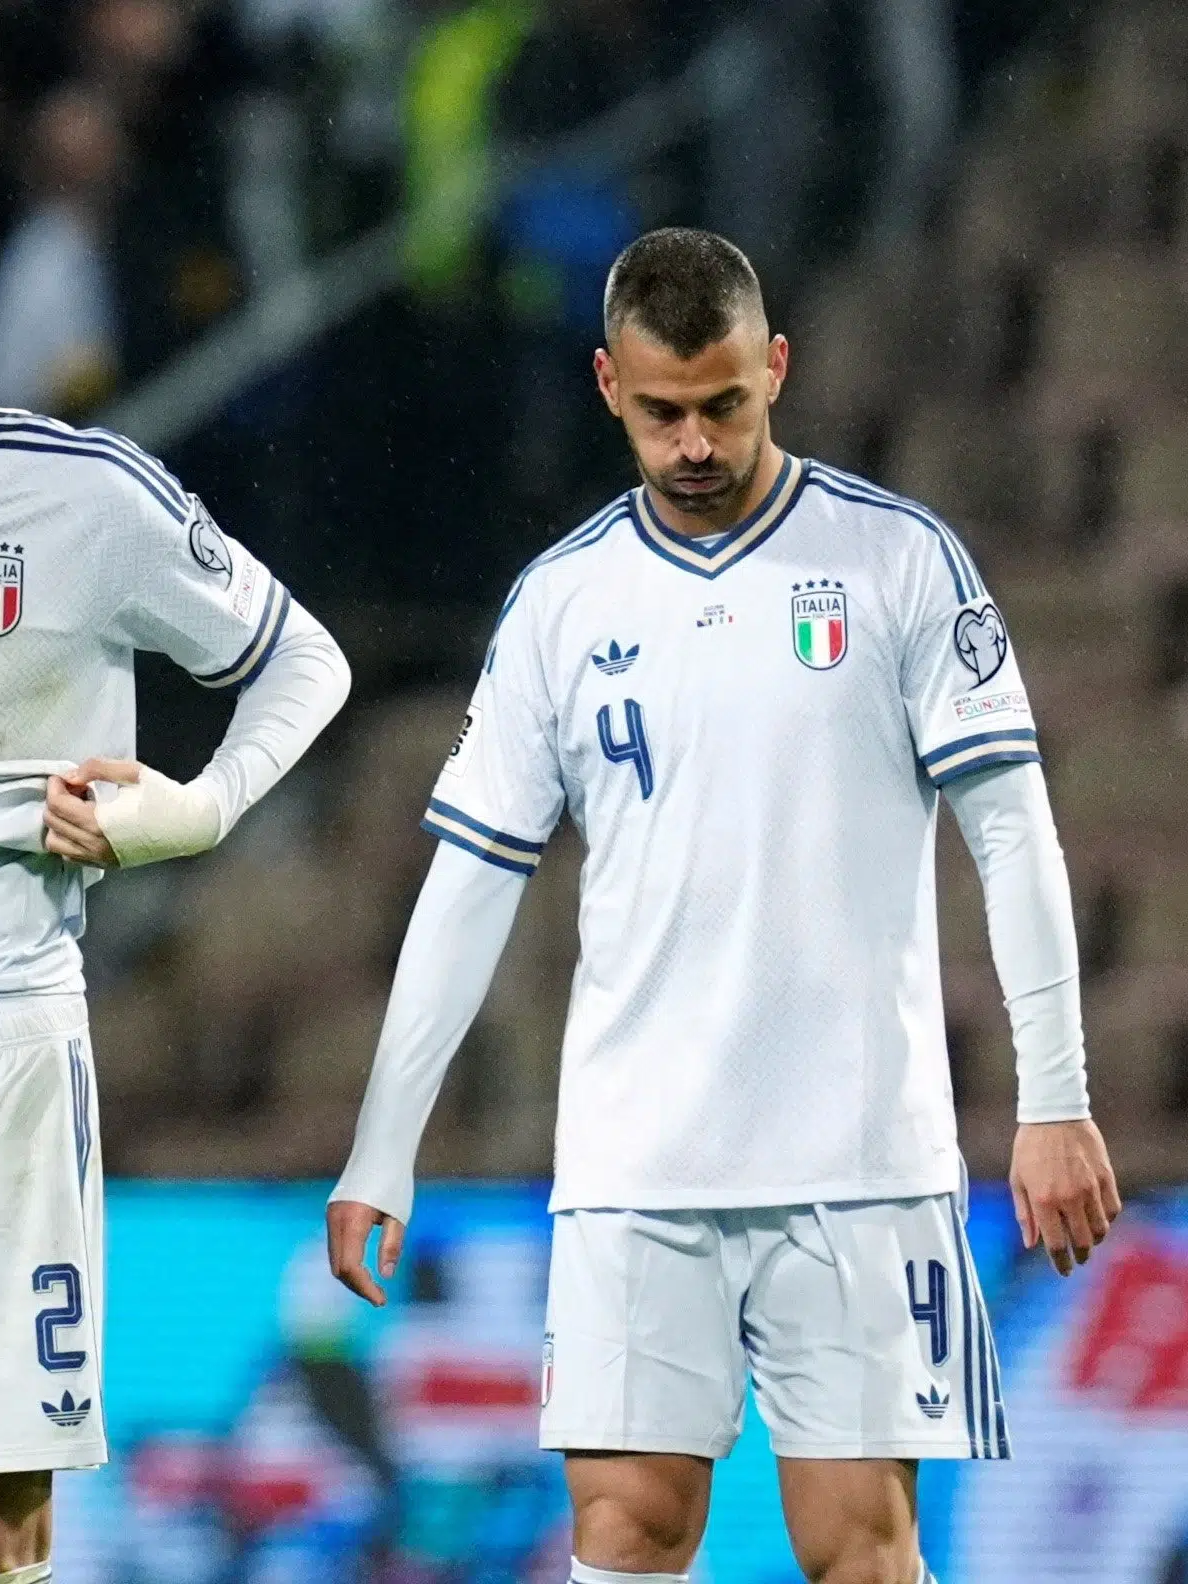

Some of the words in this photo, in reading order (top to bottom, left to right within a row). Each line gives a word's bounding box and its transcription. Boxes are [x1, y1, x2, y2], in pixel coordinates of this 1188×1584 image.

[796, 598, 841, 613] ITALIA
[596, 698, 655, 803] 4
[32, 1262, 88, 1373] 2
[905, 1259, 951, 1367] 4
